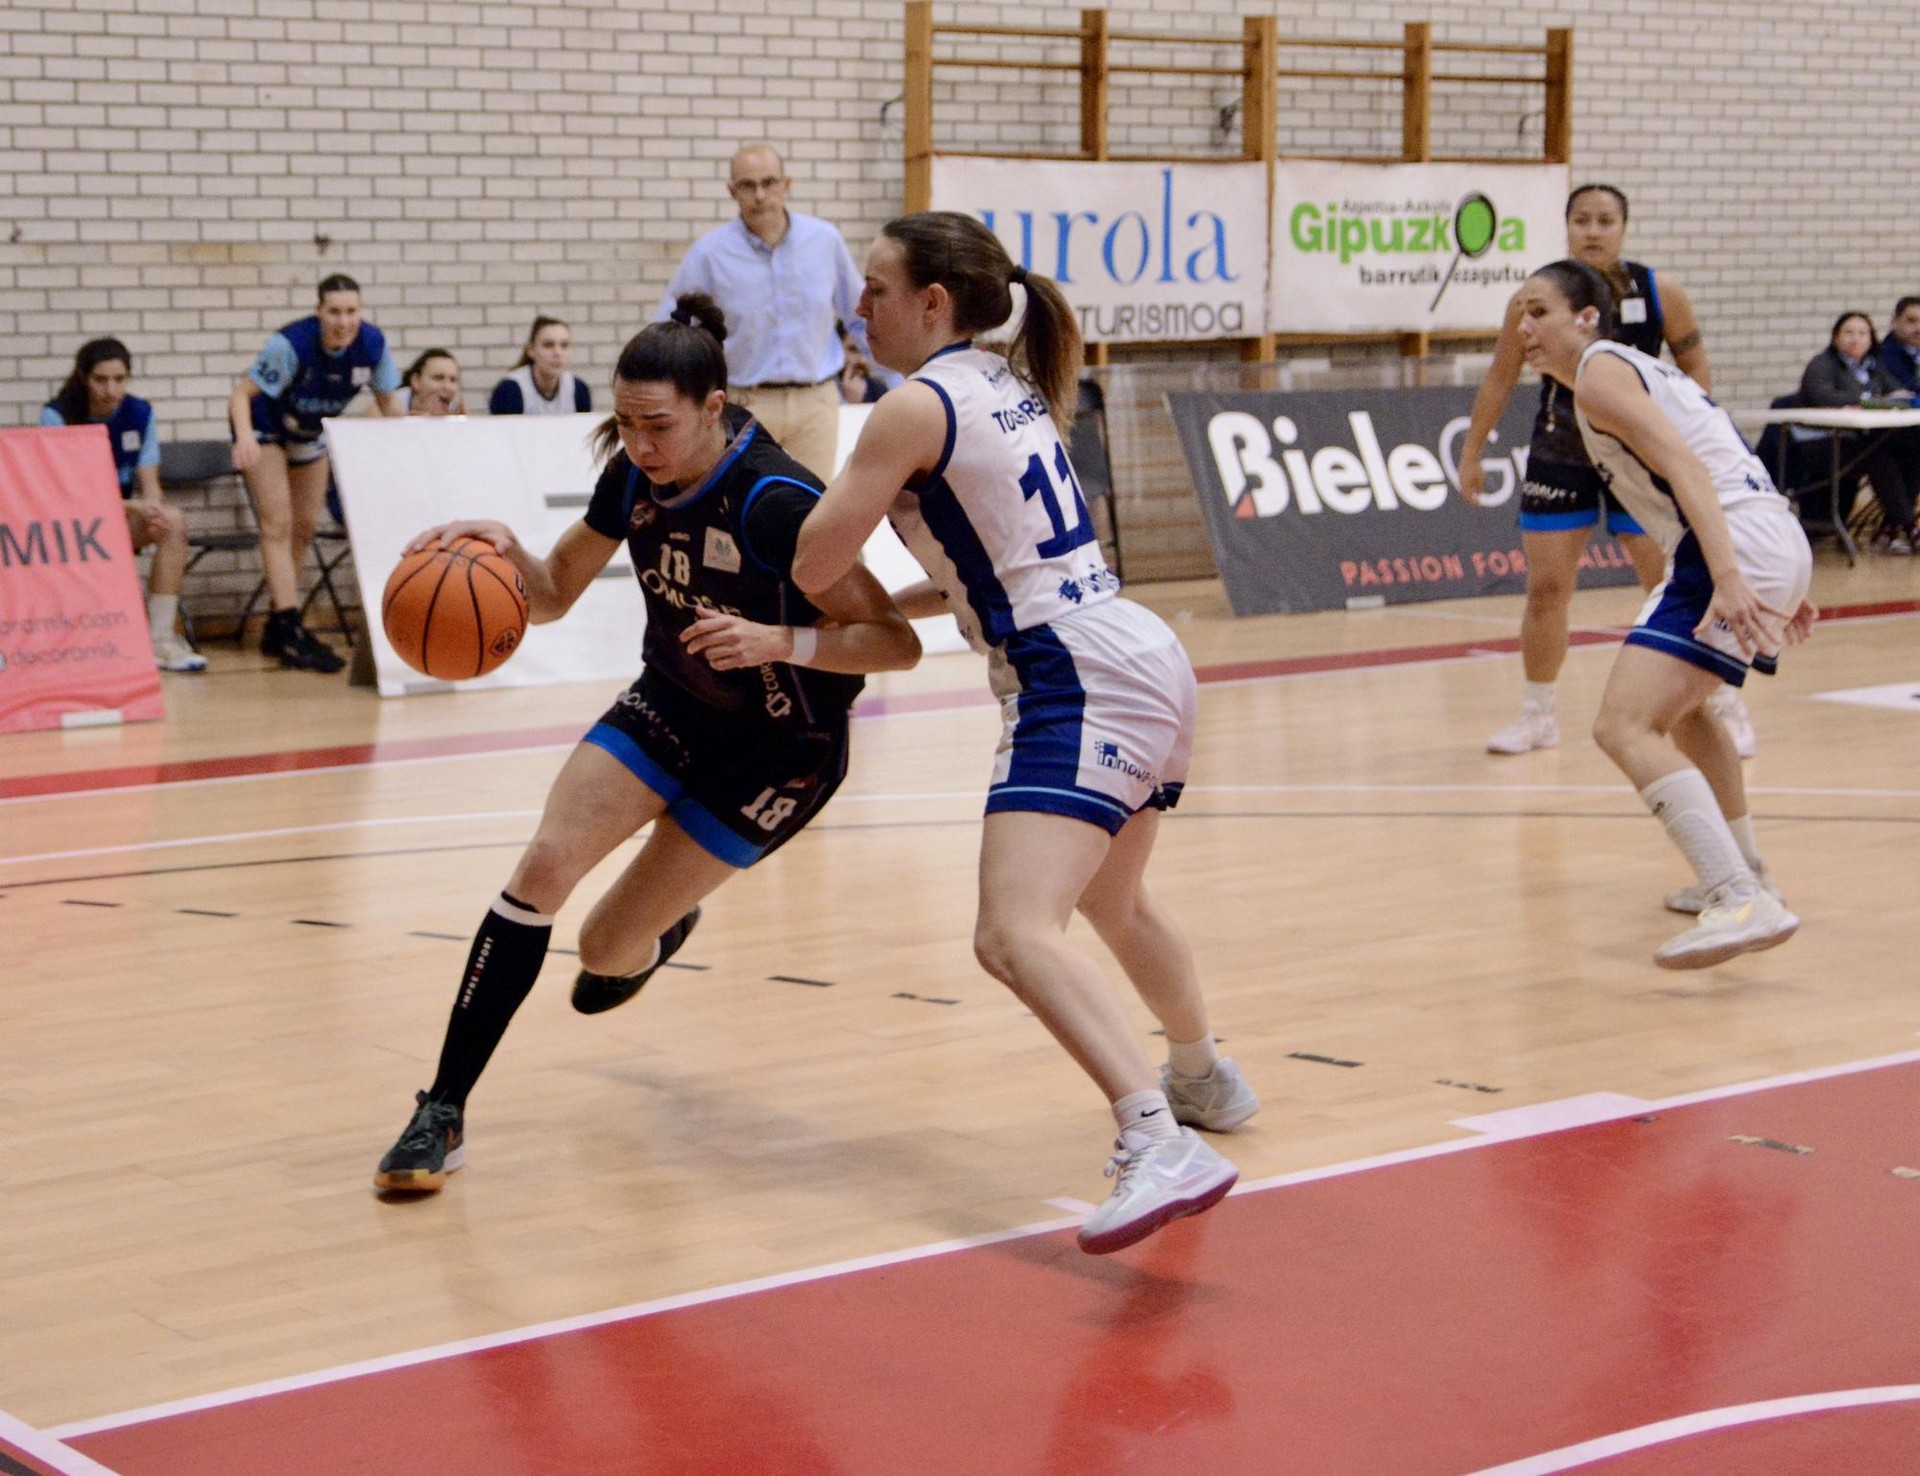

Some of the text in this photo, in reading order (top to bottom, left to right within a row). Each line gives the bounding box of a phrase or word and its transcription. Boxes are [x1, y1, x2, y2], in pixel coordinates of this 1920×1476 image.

[1340, 555, 1464, 586] PASSION
[1471, 549, 1527, 579] FOR
[739, 786, 798, 832] 18
